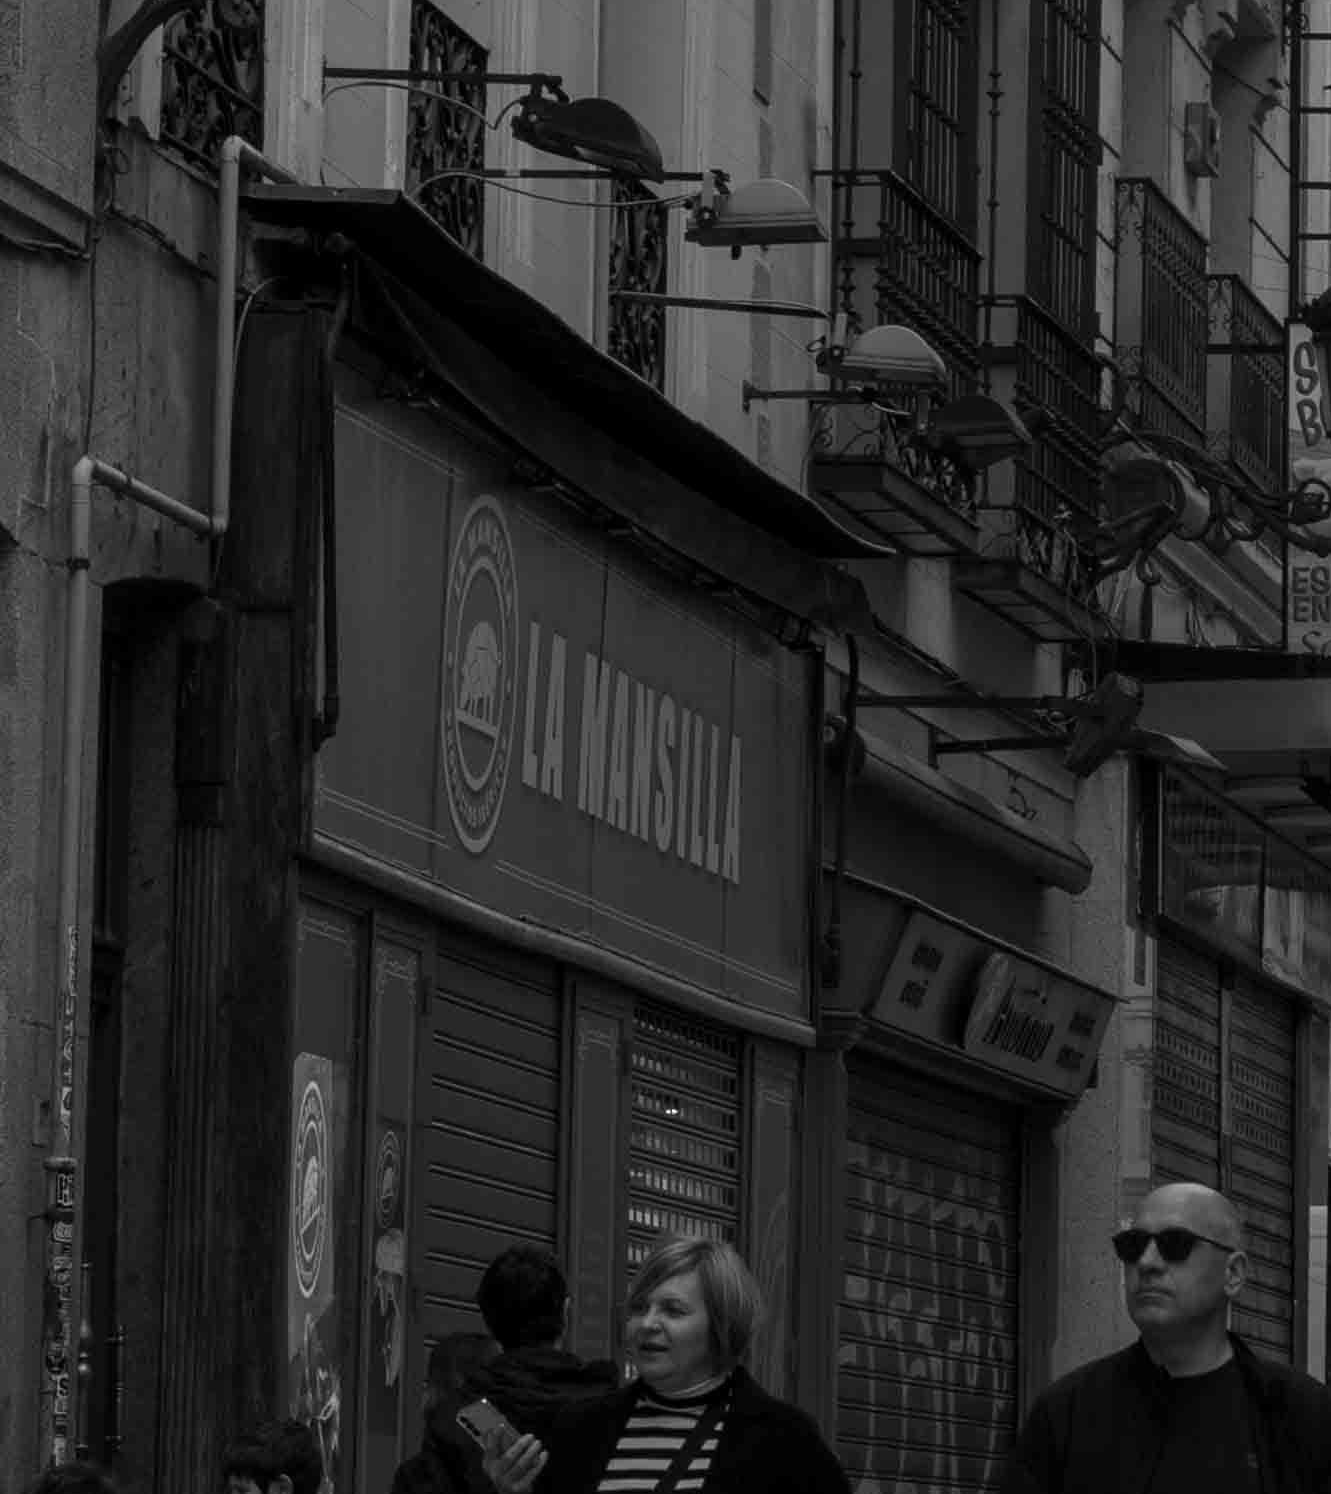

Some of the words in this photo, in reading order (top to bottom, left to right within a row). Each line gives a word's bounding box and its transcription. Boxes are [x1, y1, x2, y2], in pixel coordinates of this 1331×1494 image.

[1293, 595, 1331, 622] EN
[520, 620, 568, 802] LA
[576, 650, 744, 885] MANSILLA
